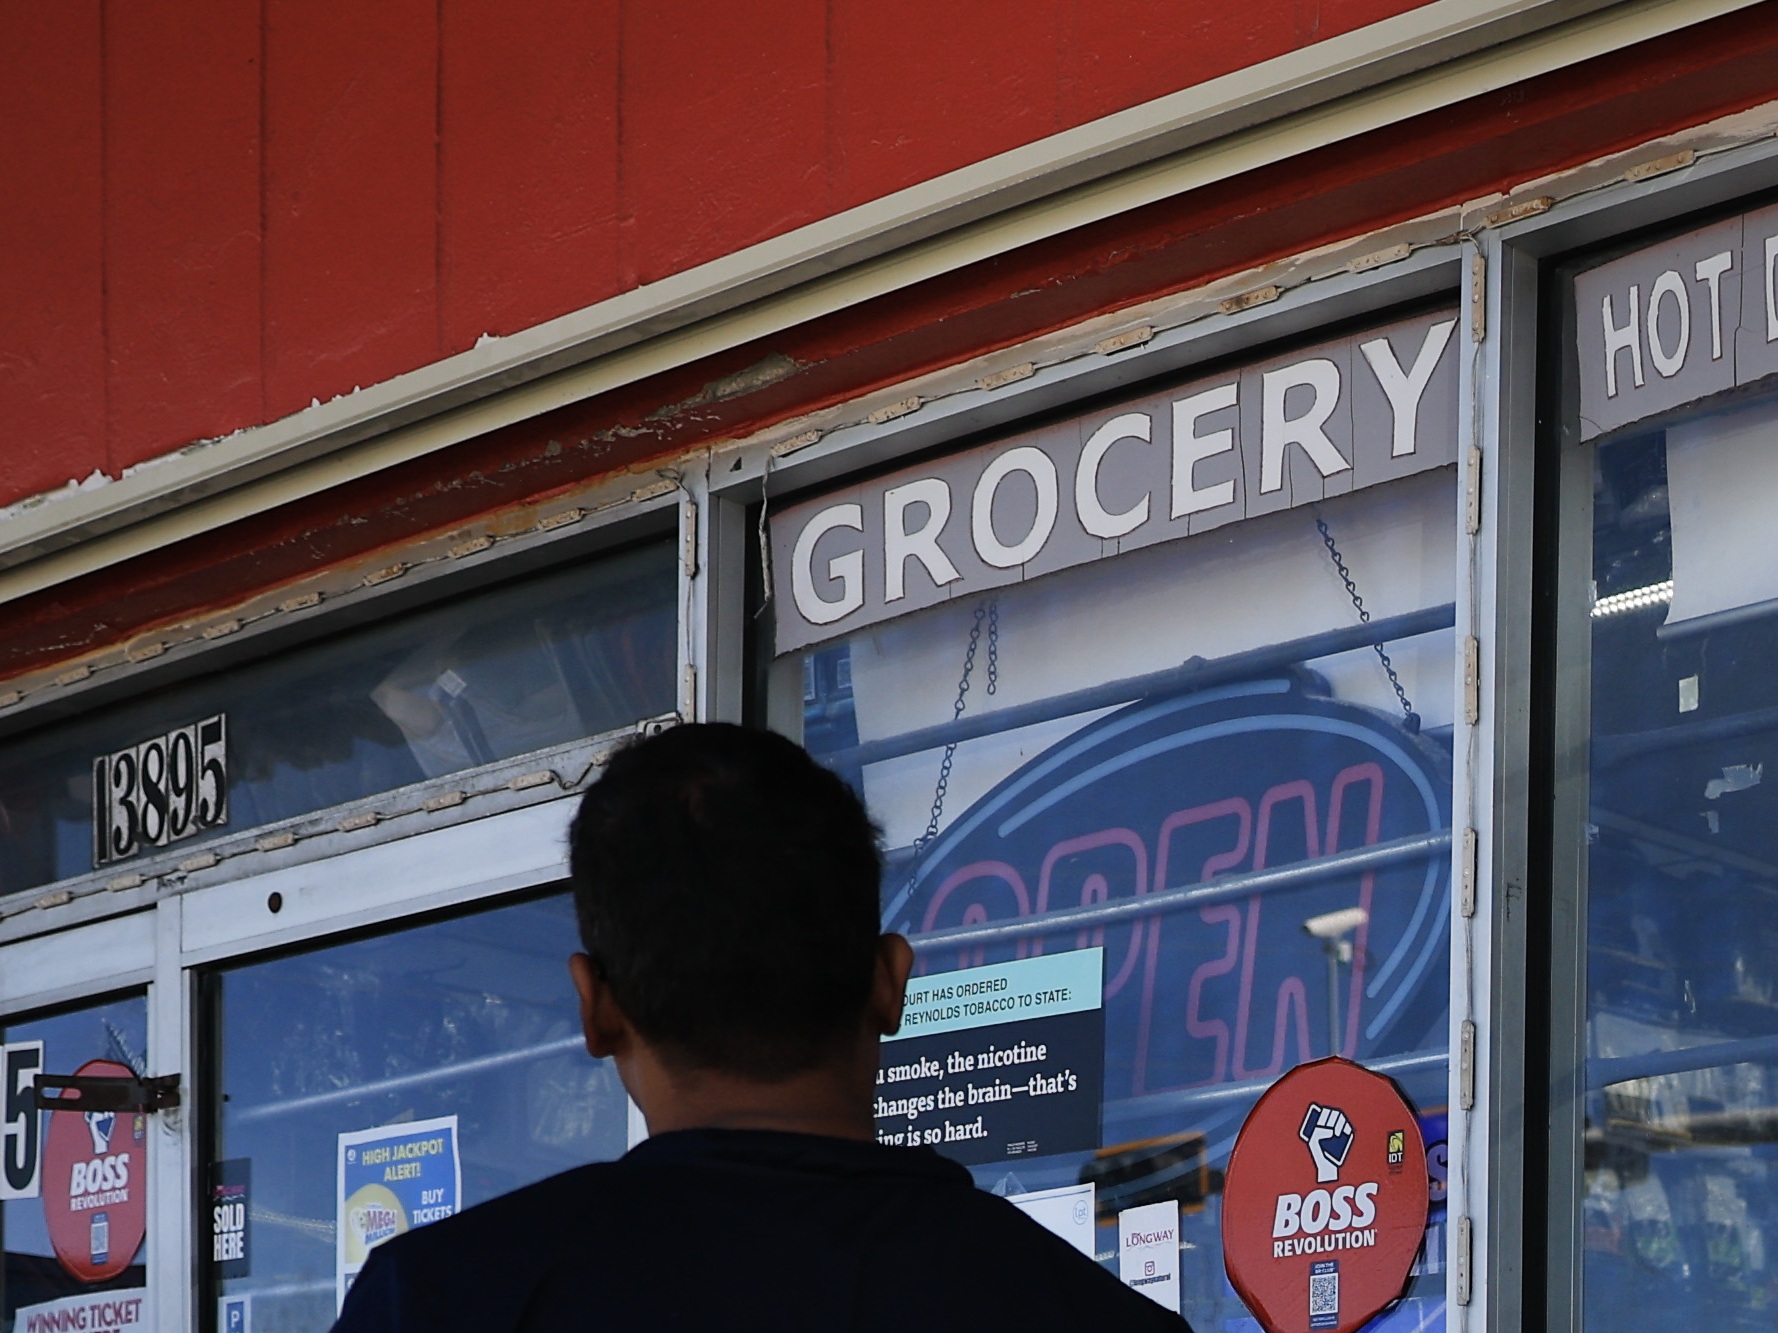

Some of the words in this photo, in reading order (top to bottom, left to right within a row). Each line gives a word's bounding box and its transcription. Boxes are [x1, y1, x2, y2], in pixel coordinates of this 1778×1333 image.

[1601, 249, 1734, 398] HOT
[790, 315, 1459, 627] GROCERY
[96, 716, 226, 861] 13895
[932, 987, 954, 1003] HAS
[956, 977, 1008, 998] ORDERED
[904, 1007, 961, 1026] REYNOLDS
[964, 998, 1015, 1017] TOBACCO
[1018, 994, 1033, 1008] TO
[1035, 988, 1072, 1006] STATE:
[887, 1056, 944, 1082] smoke,
[947, 1051, 974, 1074] the
[977, 1041, 1047, 1069] nicotine
[937, 1086, 965, 1109] the
[4, 1048, 39, 1190] 5
[907, 1125, 921, 1147] is
[923, 1127, 942, 1144] so
[944, 1115, 988, 1141] hard.
[362, 1150, 390, 1165] HIGH
[392, 1138, 444, 1161] JACKPOT
[1388, 1152, 1402, 1164] IDT
[70, 1153, 130, 1197] BOSS
[383, 1162, 422, 1182] ALERT!
[70, 1188, 129, 1211] REVOLUTION
[421, 1189, 444, 1203] BUY
[1272, 1182, 1379, 1239] BOSS
[213, 1203, 245, 1233] SOLD
[412, 1204, 452, 1225] TICKETS
[213, 1233, 245, 1262] HERE
[1273, 1229, 1377, 1259] REVOLUTION
[90, 1298, 143, 1328] TICKET
